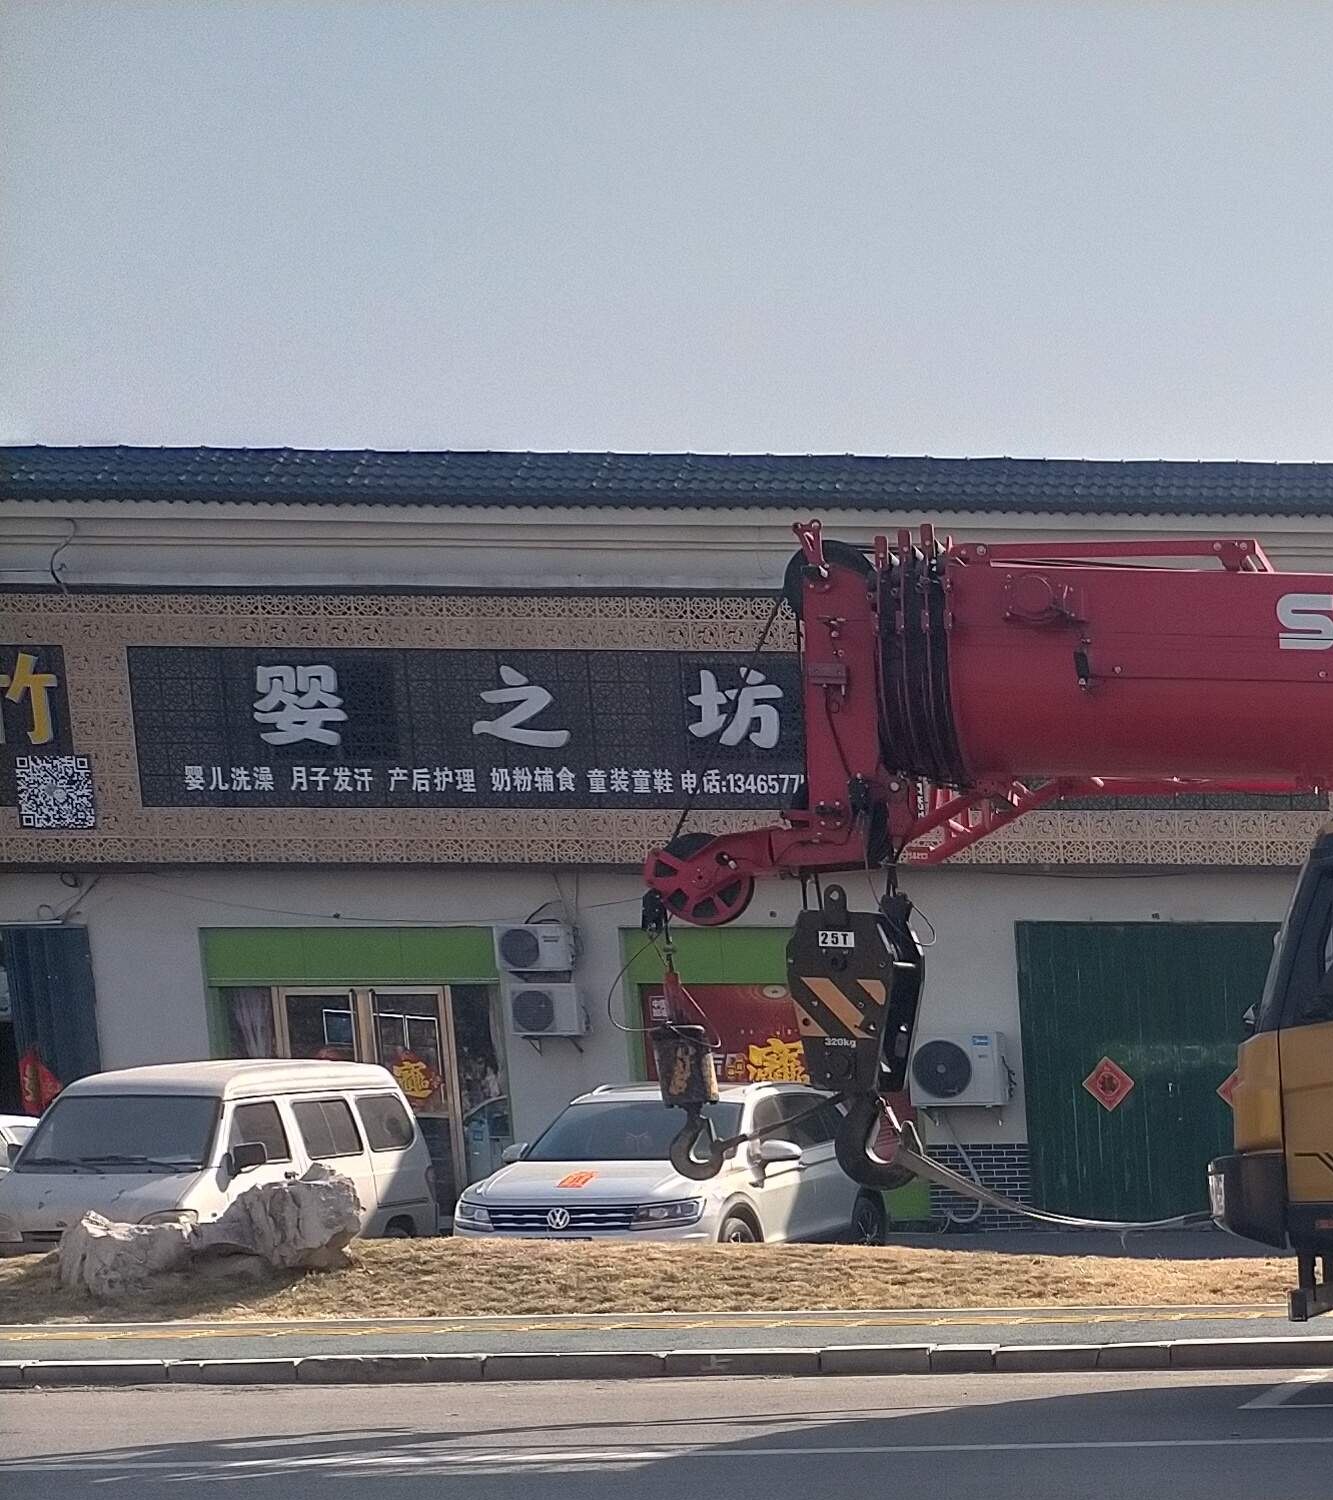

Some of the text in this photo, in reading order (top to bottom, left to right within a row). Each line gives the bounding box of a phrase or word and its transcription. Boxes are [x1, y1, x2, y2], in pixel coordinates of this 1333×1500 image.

[253, 665, 784, 749] 婴之坊
[184, 764, 805, 794] 婴儿洗澡 月子发汗 产后护理 奶粉辅食 童装童鞋 电话:1346577
[820, 932, 849, 945] 25T
